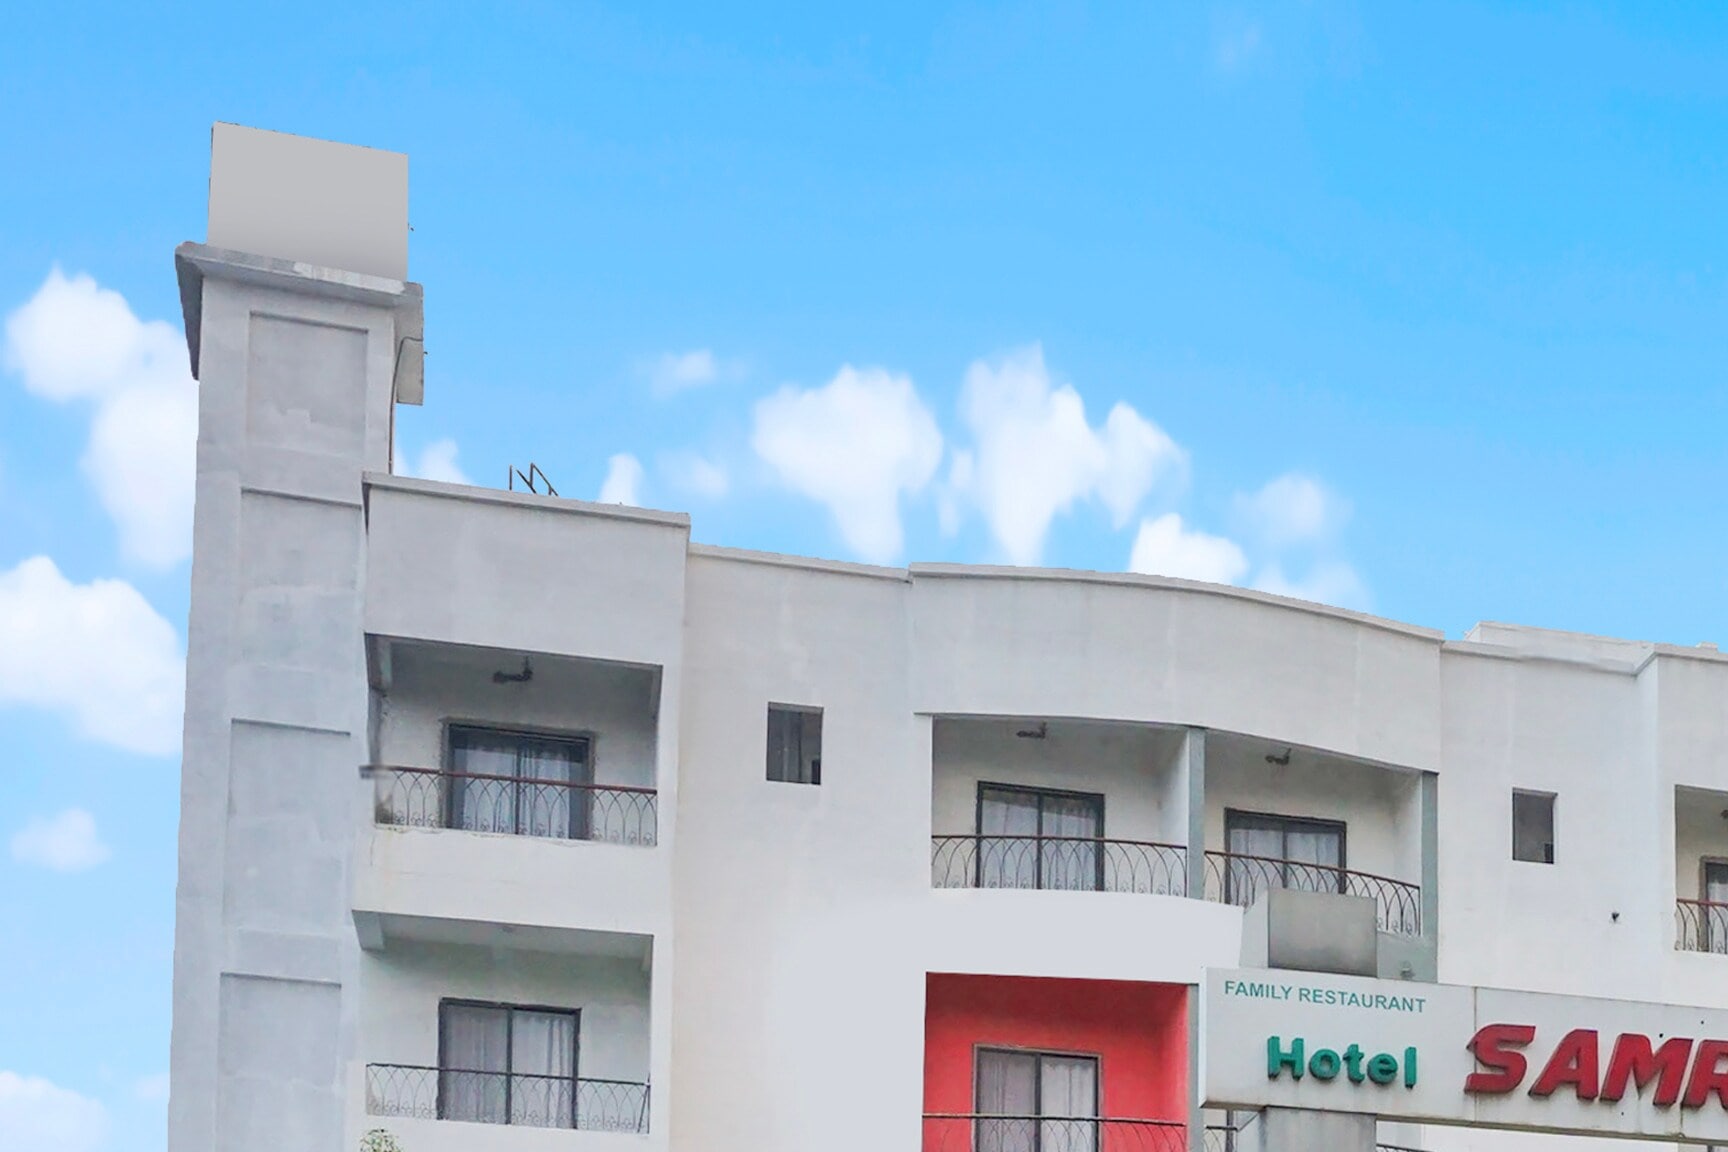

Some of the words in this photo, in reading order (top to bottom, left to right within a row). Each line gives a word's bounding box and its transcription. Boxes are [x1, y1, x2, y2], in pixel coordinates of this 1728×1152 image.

[1224, 980, 1293, 1001] FAMILY
[1298, 987, 1426, 1014] RESTAURANT
[1266, 1035, 1418, 1090] Hotel
